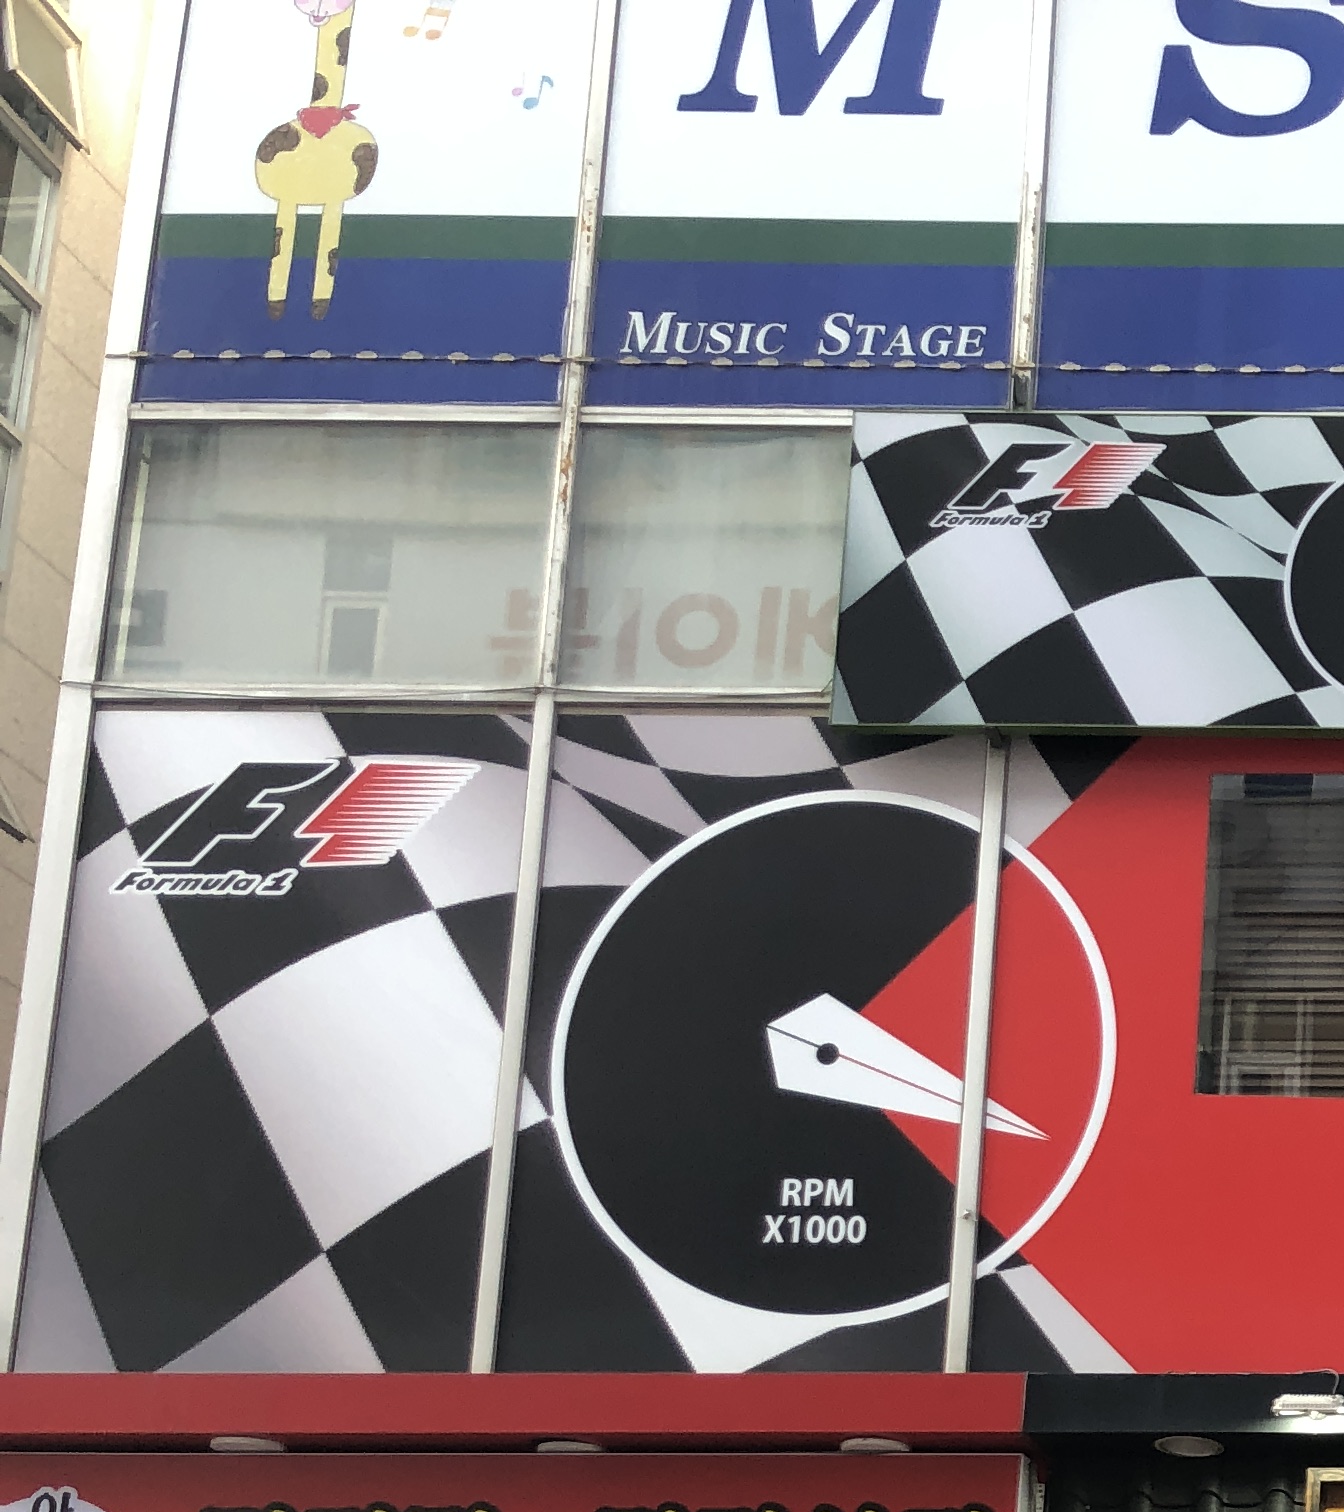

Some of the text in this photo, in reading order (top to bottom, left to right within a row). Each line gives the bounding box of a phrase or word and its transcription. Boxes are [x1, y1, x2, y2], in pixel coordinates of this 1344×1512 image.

[933, 510, 1026, 528] Formula
[112, 869, 254, 896] Formula
[780, 1178, 855, 1207] RPM
[762, 1214, 867, 1245] X1000
